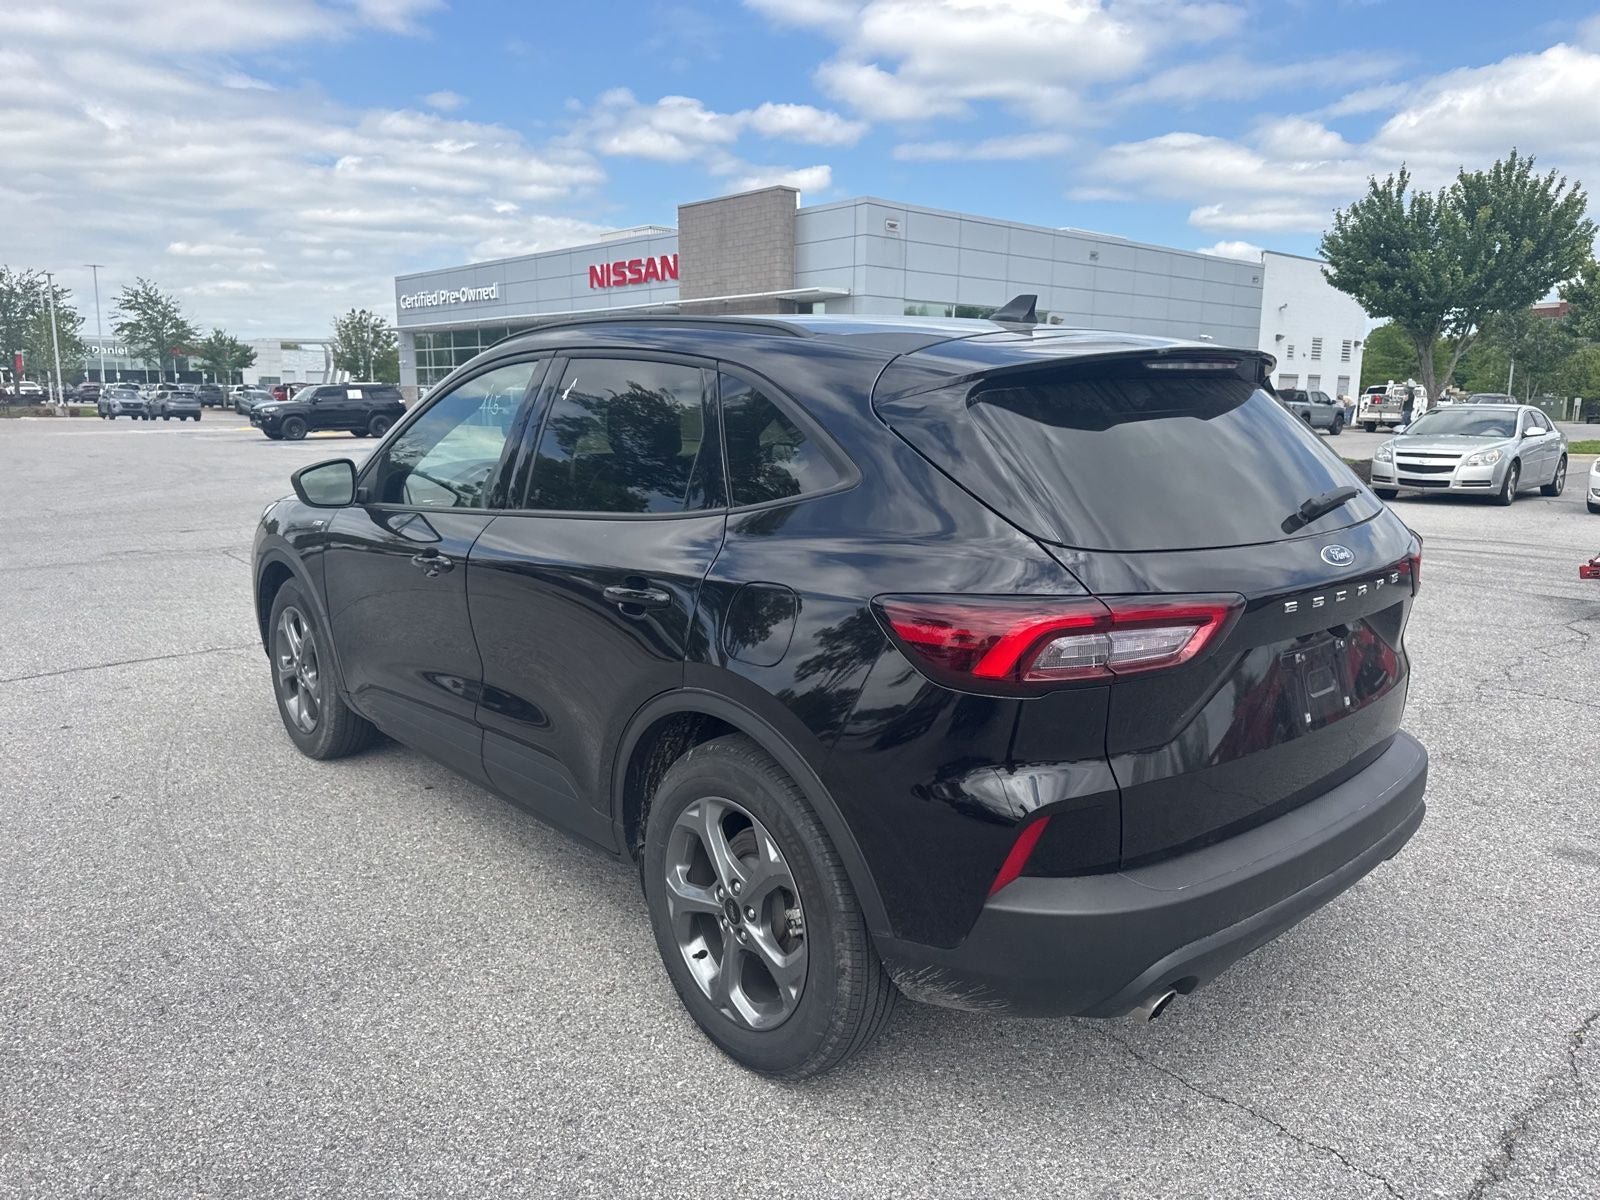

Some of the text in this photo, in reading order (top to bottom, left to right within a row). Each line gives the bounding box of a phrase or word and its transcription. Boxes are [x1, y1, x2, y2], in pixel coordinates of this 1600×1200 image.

[589, 254, 679, 289] NISSAN
[400, 282, 497, 309] Certified Pre-Owned
[1284, 572, 1400, 614] ESCAPE
